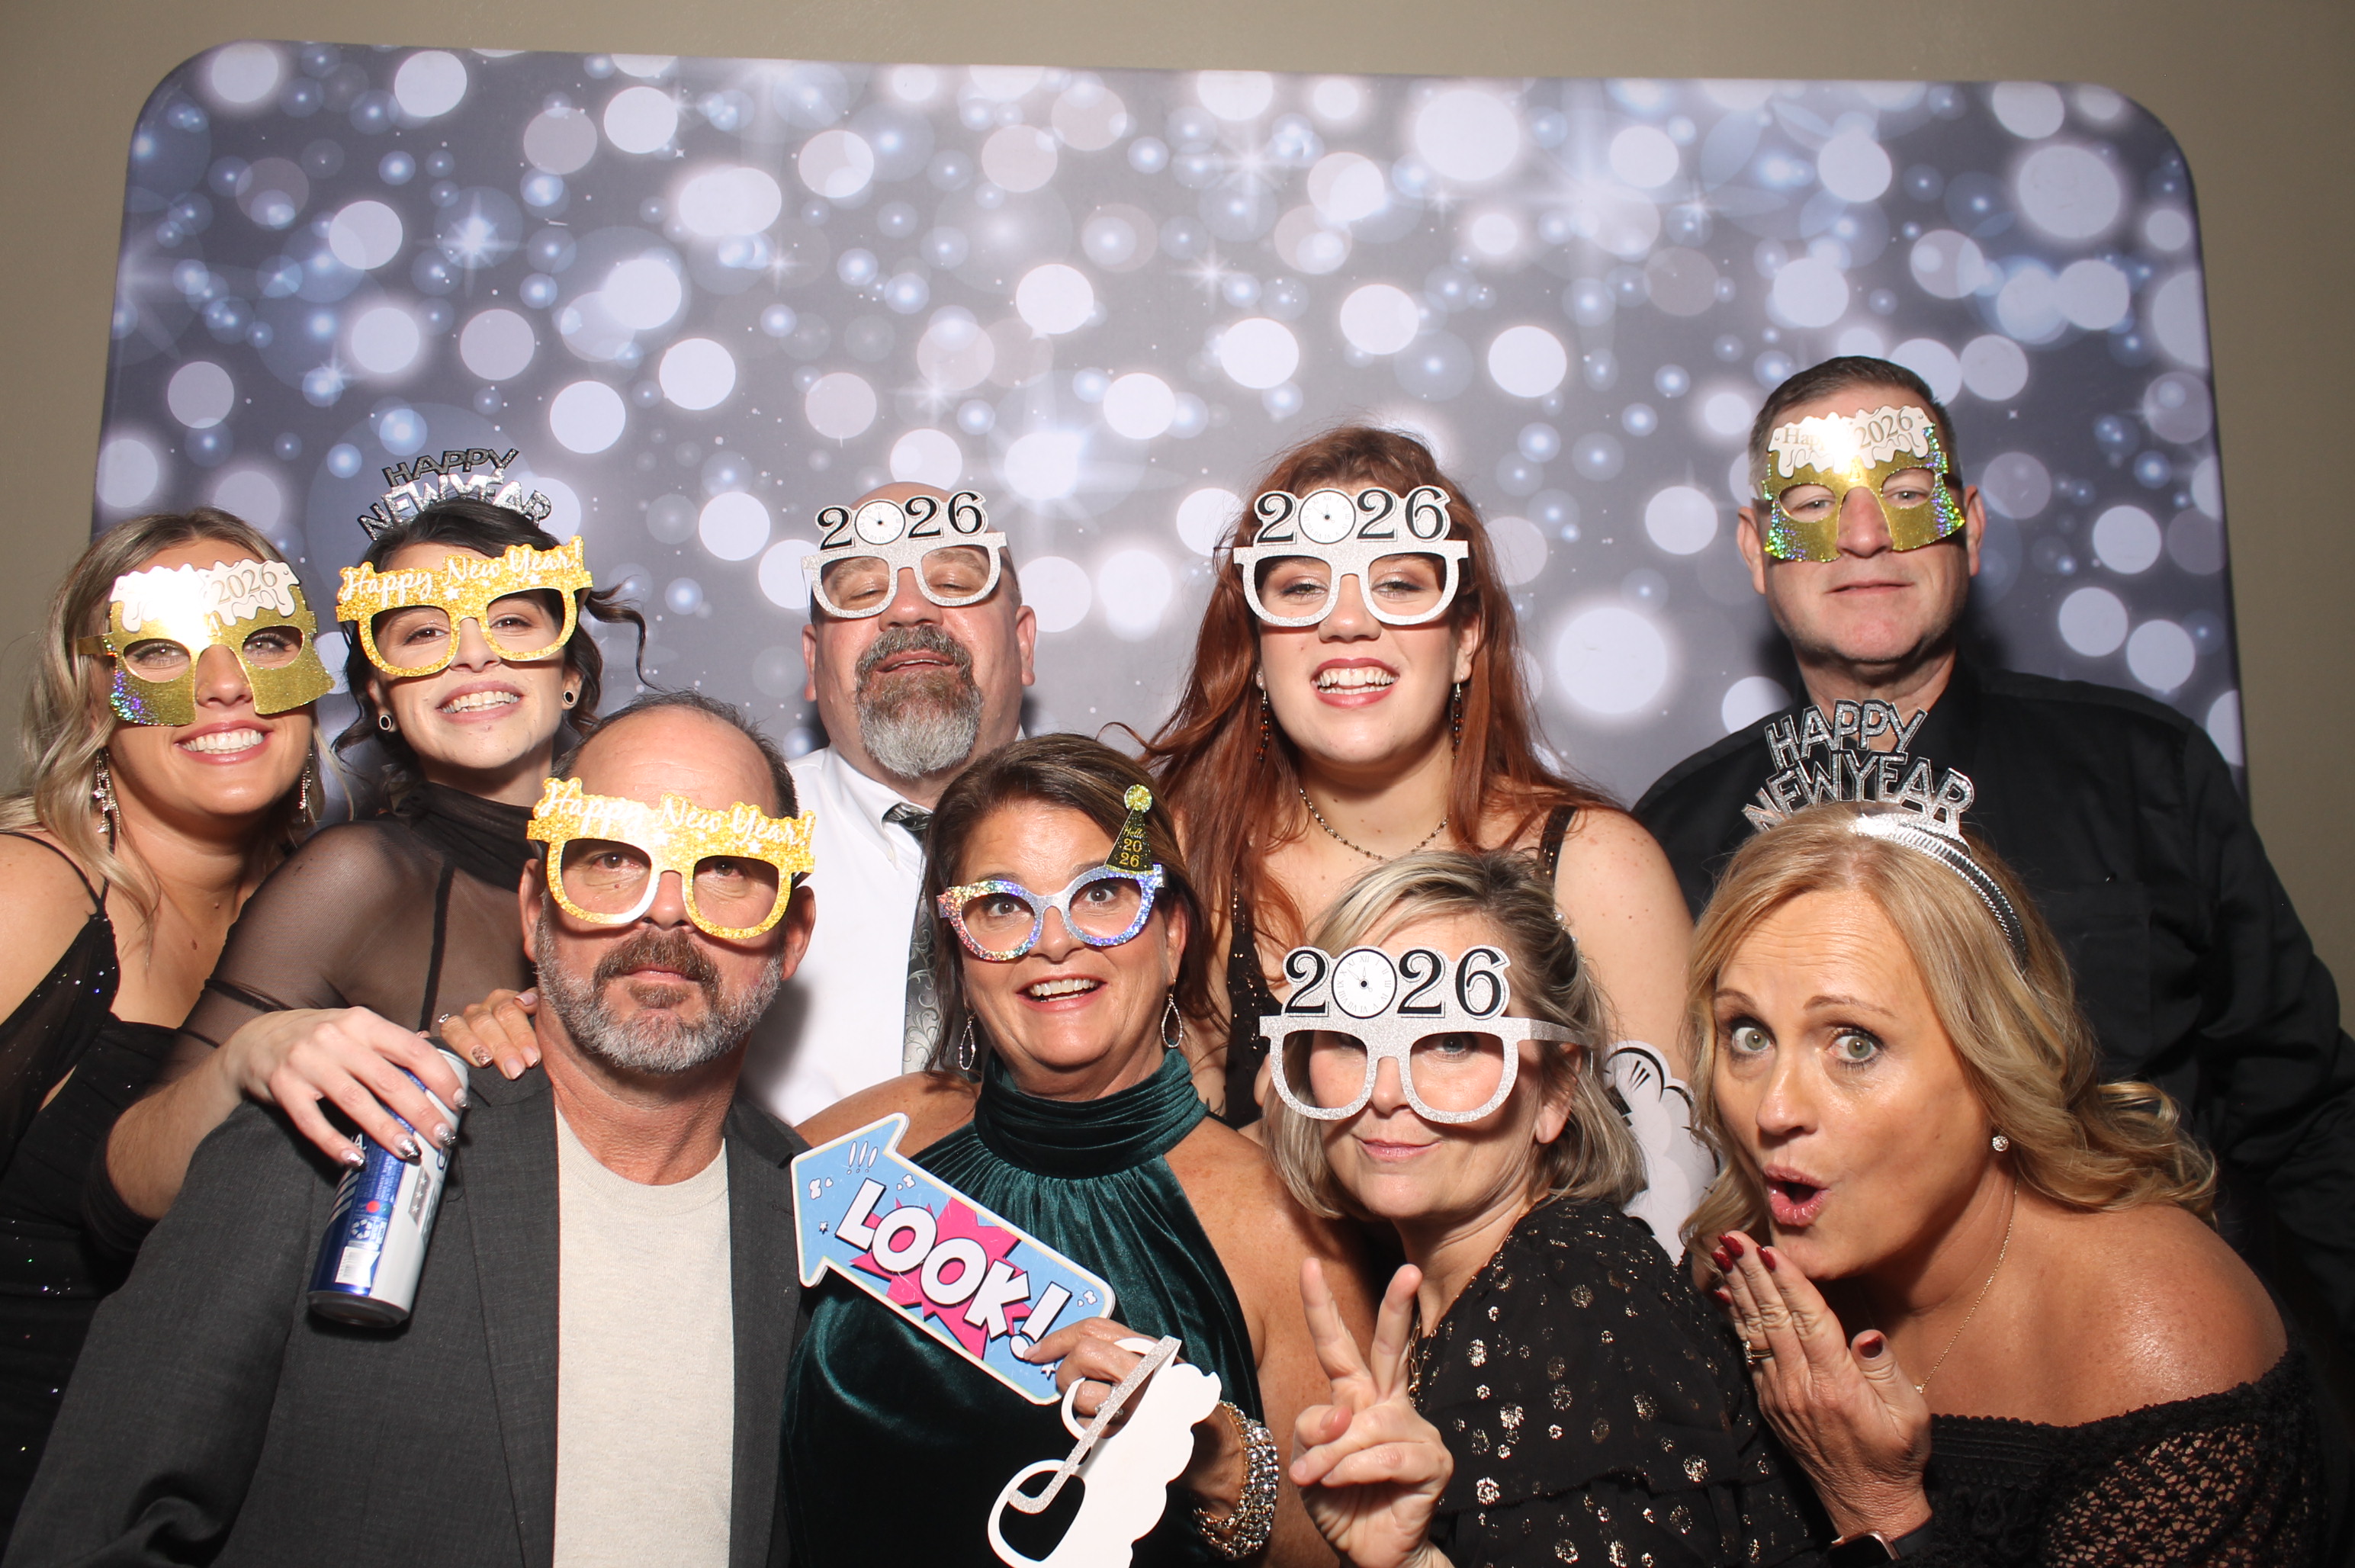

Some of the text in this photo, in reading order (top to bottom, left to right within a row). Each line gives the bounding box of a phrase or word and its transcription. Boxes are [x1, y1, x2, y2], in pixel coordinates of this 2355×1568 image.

[1854, 408, 1913, 449] 2026
[382, 448, 519, 487] HAPPY
[818, 491, 983, 551] 2026
[1258, 487, 1447, 545] 2026
[211, 563, 278, 605] 2026
[342, 540, 581, 607] Happy New Year!
[1765, 699, 1928, 773] HAPPY
[538, 782, 812, 846] Happy New Year!
[1119, 853, 1140, 867] 26
[1123, 838, 1142, 853] 20
[1285, 948, 1506, 1019] 2026
[835, 1178, 1072, 1361] LOOK!
